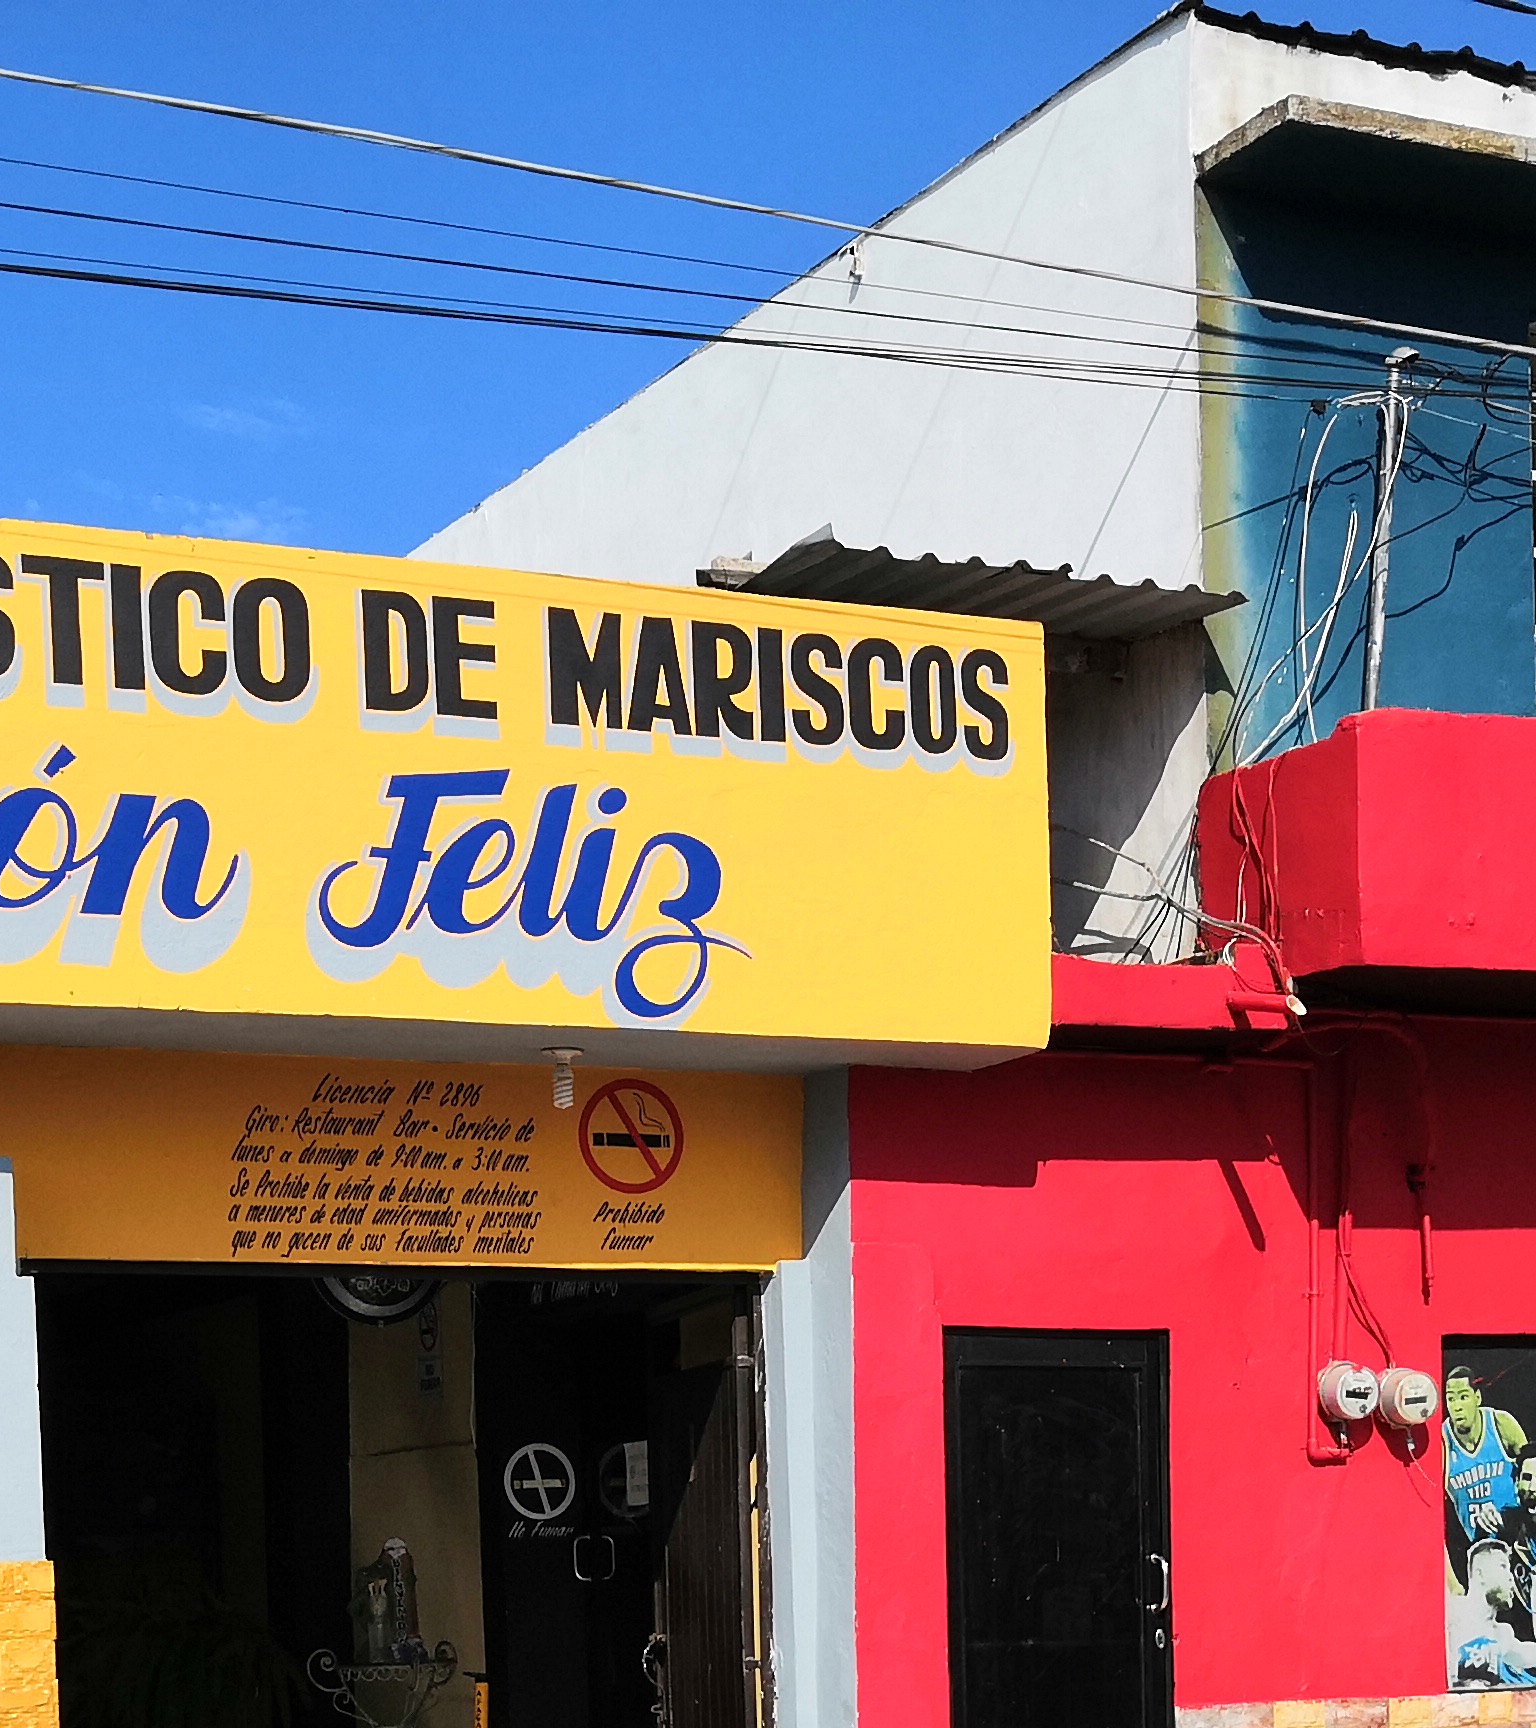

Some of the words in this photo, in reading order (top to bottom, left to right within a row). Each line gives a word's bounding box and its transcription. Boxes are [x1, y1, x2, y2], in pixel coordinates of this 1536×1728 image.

[361, 588, 499, 726] DE
[546, 605, 1011, 766] MARISCOS
[316, 767, 752, 1018] Feliz
[312, 1073, 395, 1105] Licencia
[440, 1081, 484, 1107] 2896
[245, 1105, 288, 1138] Giro:
[291, 1108, 385, 1141] Restaurant
[445, 1113, 512, 1142] Servicio
[515, 1118, 535, 1143] de
[231, 1134, 274, 1164] lunes
[279, 1150, 292, 1163] a
[298, 1140, 359, 1171] domingo
[366, 1144, 384, 1167] de
[452, 1156, 463, 1171] a
[230, 1167, 250, 1198] Se
[255, 1170, 310, 1200] Prohibe
[313, 1172, 331, 1200] la
[334, 1174, 375, 1201] venta
[379, 1177, 396, 1203] de
[398, 1176, 454, 1204] bebidas
[461, 1180, 539, 1208] alcoholicas
[228, 1203, 241, 1222] a
[245, 1204, 307, 1224] menores
[310, 1203, 326, 1224] de
[330, 1203, 368, 1225] edad
[372, 1204, 462, 1227] uniformados
[465, 1214, 475, 1234] y
[478, 1210, 542, 1234] personas
[592, 1200, 666, 1224] Prohibido
[232, 1229, 257, 1257] que
[262, 1230, 282, 1250] no
[281, 1231, 332, 1257] gocen
[337, 1227, 354, 1251] de
[360, 1233, 386, 1251] sus
[473, 1229, 535, 1254] mentales
